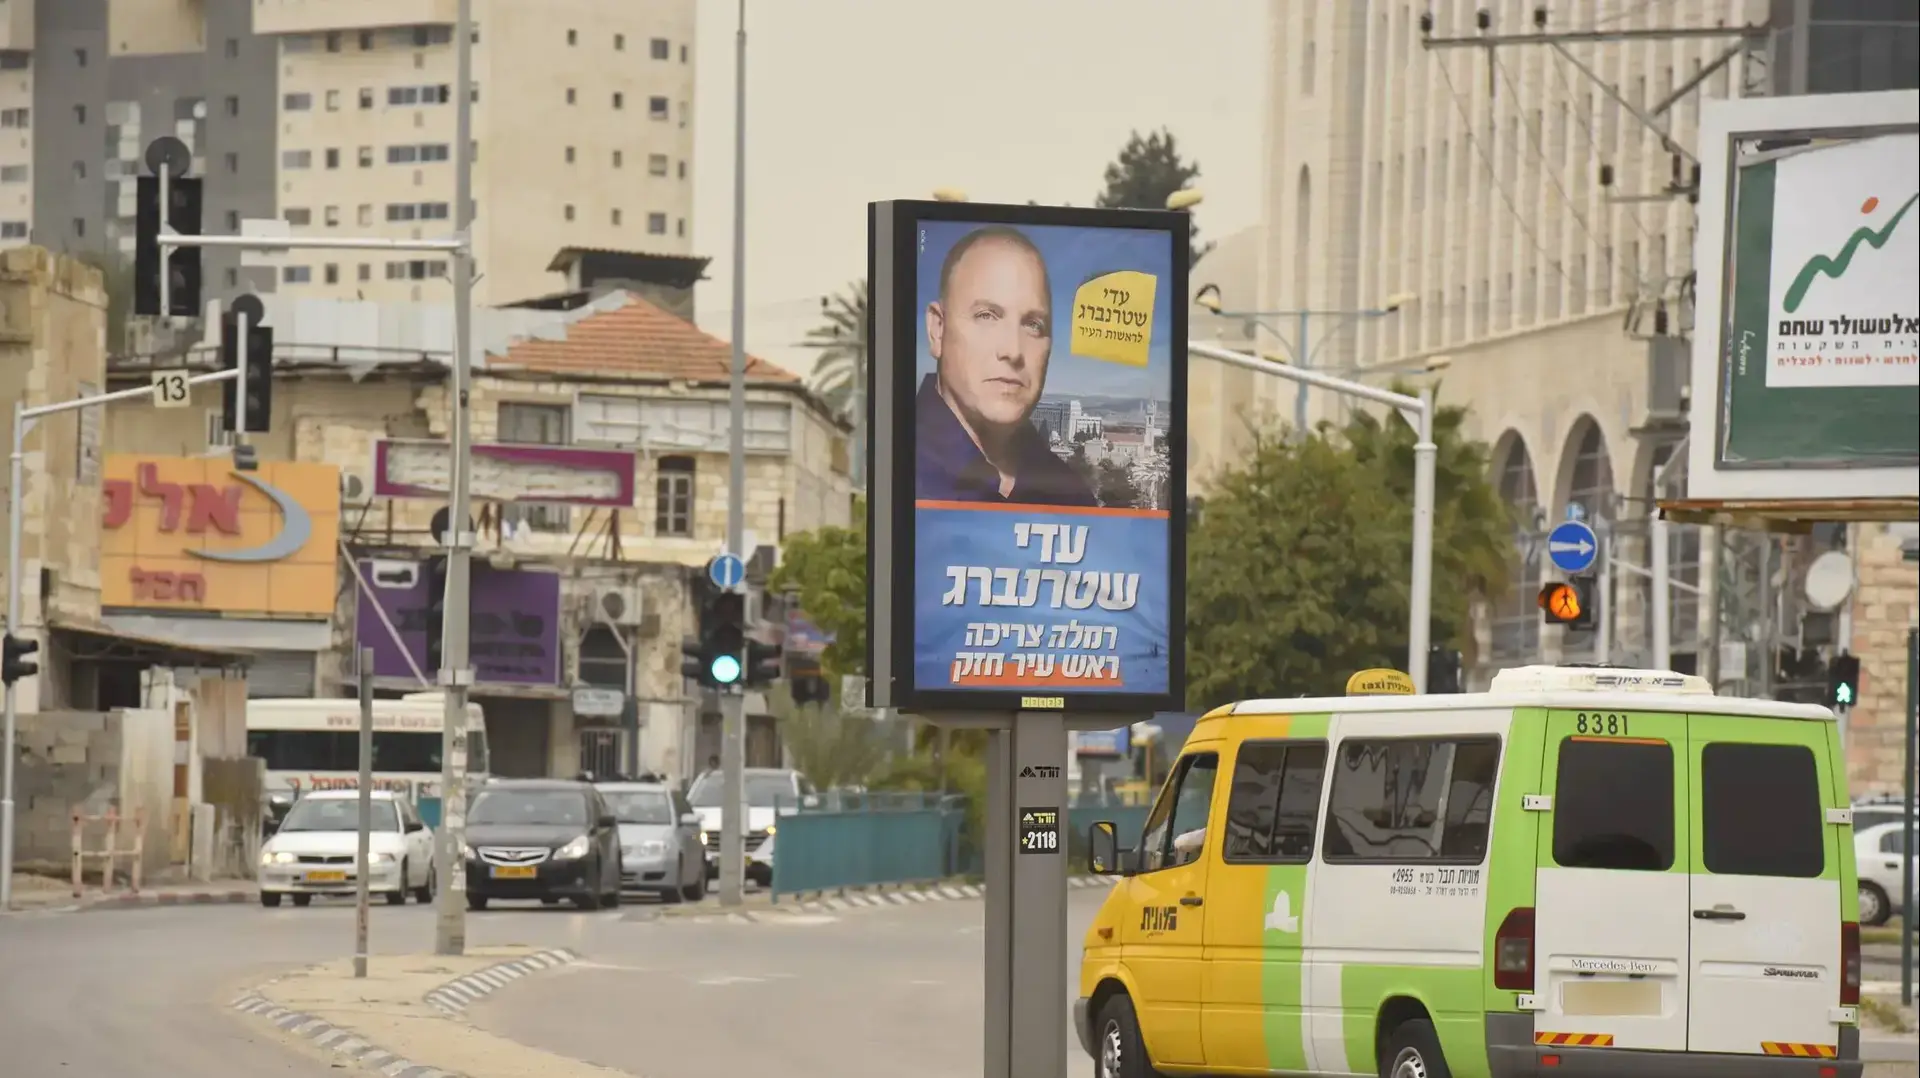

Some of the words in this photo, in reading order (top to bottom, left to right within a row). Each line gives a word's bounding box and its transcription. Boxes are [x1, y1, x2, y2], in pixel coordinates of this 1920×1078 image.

[1103, 287, 1130, 306] עדי
[1078, 304, 1148, 327] שטרנברג
[1829, 313, 1919, 335] אלטשולר
[1079, 326, 1102, 338] העיר
[1105, 329, 1143, 343] לראשות
[1778, 320, 1824, 336] שחם
[1777, 340, 1859, 351] השקעות
[156, 376, 186, 402] 13
[1014, 522, 1089, 564] עדי
[942, 565, 1141, 611] שטרנברג
[964, 621, 1045, 648] צריכה
[1047, 619, 1119, 650] רמלה
[952, 652, 1006, 683] חזק
[1011, 653, 1057, 678] עיר
[1061, 654, 1120, 679] ראש
[1577, 713, 1628, 735] 8381
[1438, 867, 1455, 884] תבל
[1571, 958, 1658, 972] Mercedes-Benz
